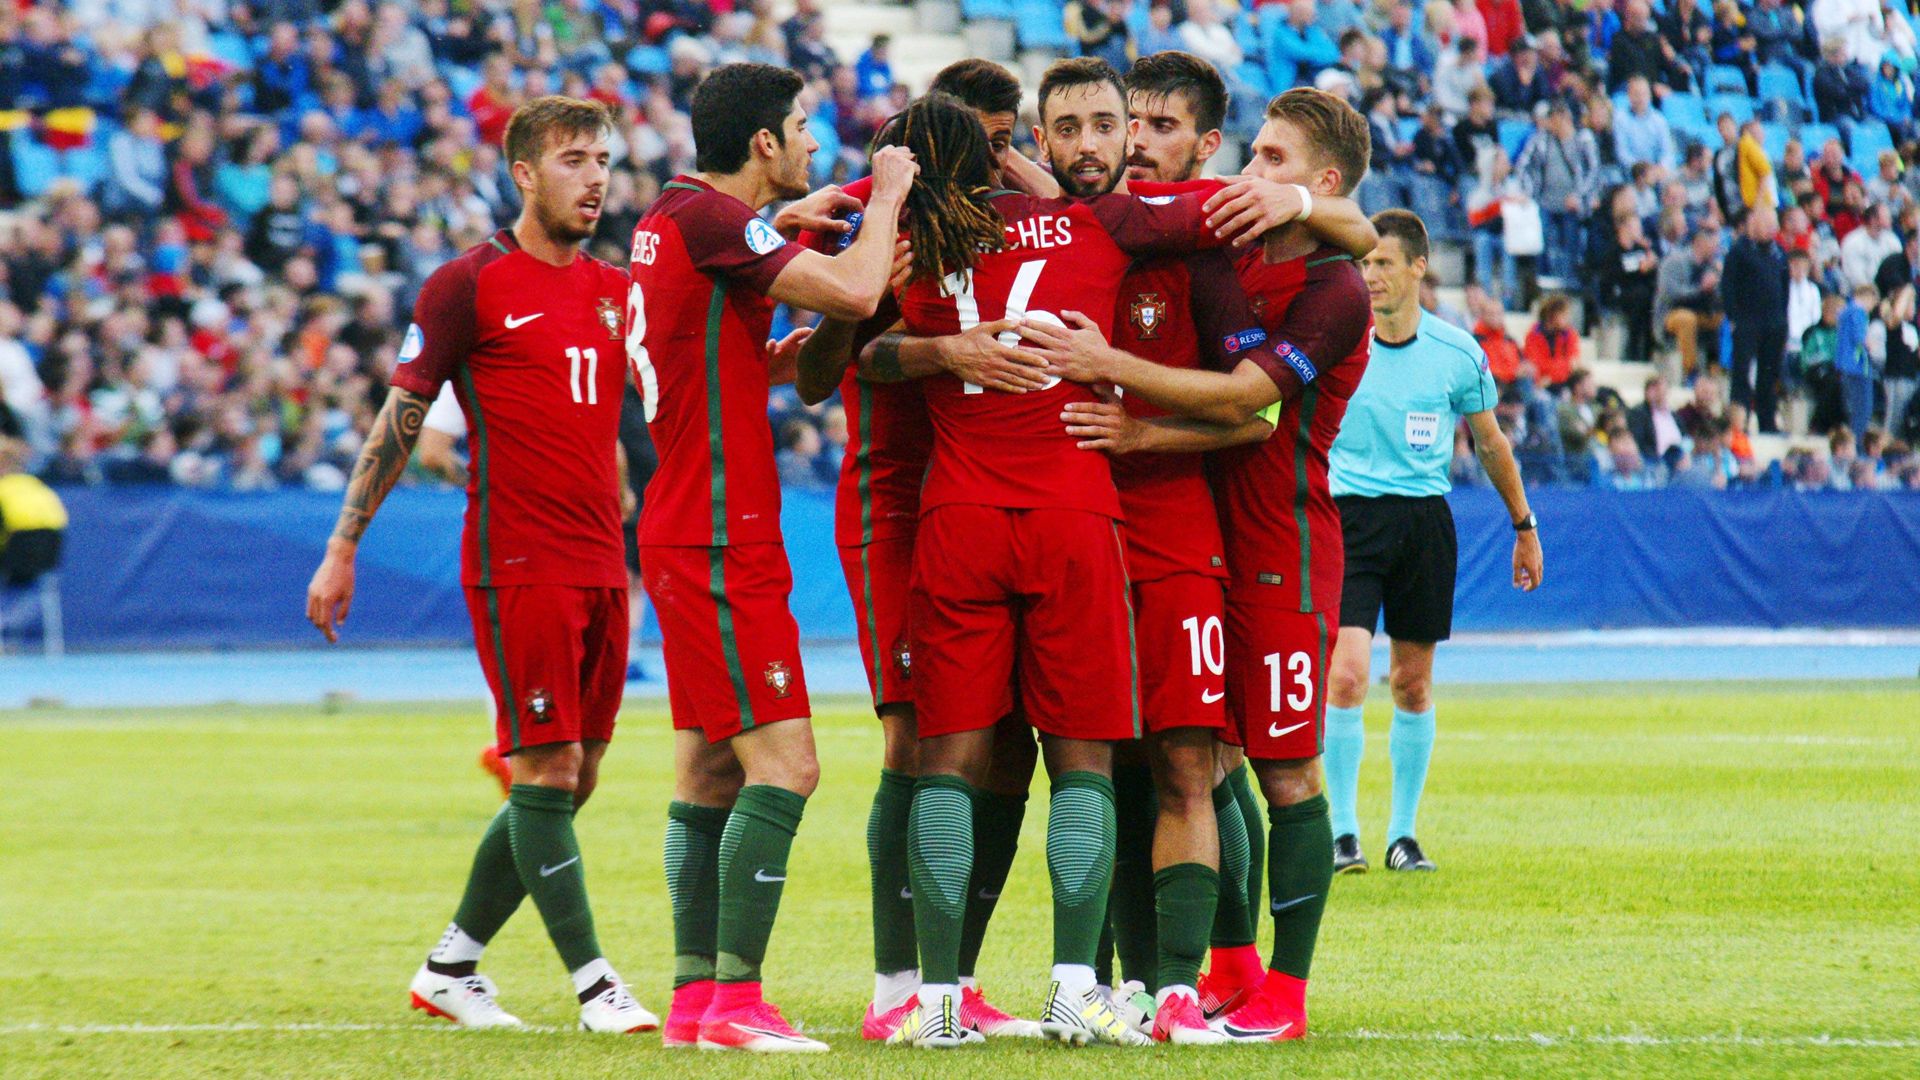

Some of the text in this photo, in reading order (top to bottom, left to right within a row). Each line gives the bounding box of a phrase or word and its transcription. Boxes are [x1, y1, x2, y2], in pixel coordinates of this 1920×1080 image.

[977, 216, 1073, 254] CHES
[940, 259, 1069, 395] 16
[565, 346, 598, 405] 11
[1287, 351, 1316, 382] RESPECT
[1412, 429, 1431, 438] FIFA
[1182, 615, 1225, 676] 10
[1263, 651, 1314, 712] 13
